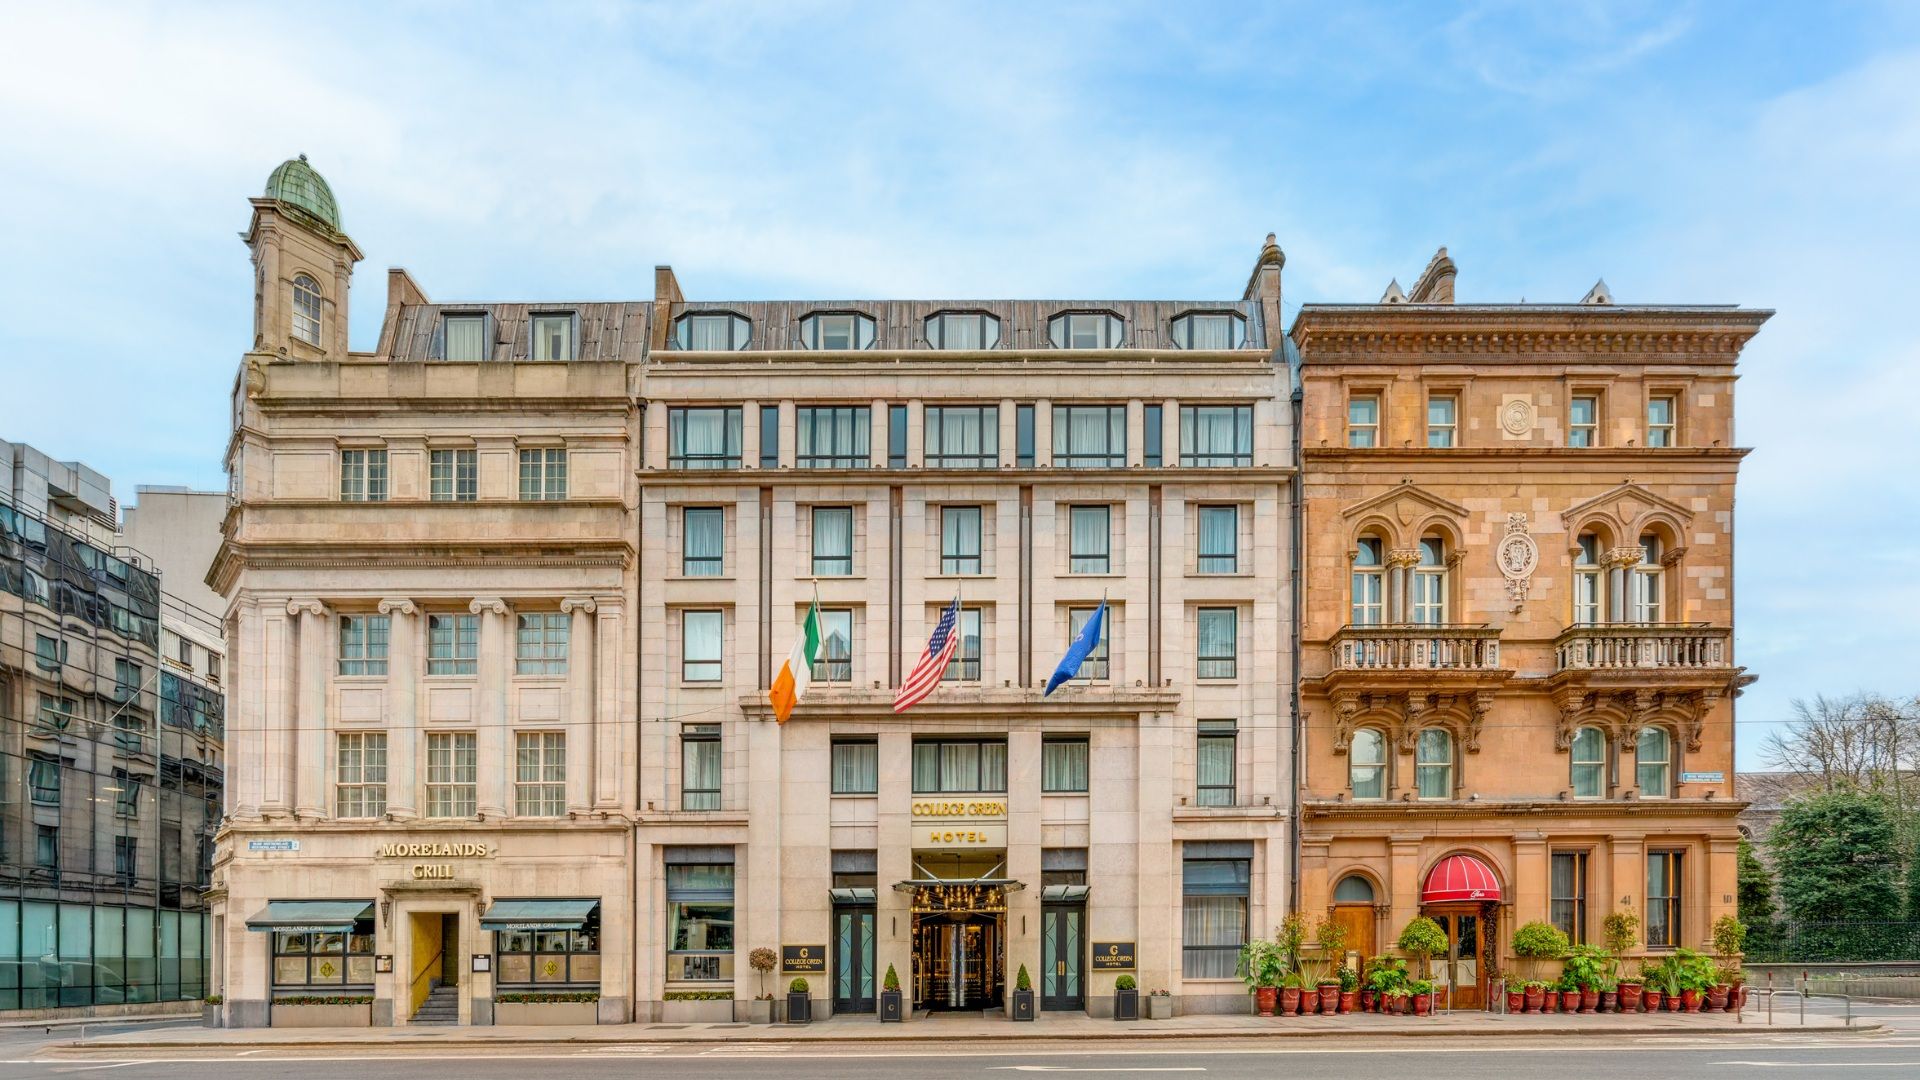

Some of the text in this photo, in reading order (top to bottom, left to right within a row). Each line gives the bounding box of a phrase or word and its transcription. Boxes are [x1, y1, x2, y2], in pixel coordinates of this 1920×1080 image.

[911, 803, 1007, 816] COLLEGE GREEN
[931, 832, 987, 842] HOTEL
[382, 843, 487, 857] MORELANDS
[412, 864, 454, 879] GRILL
[1620, 895, 1631, 905] 41
